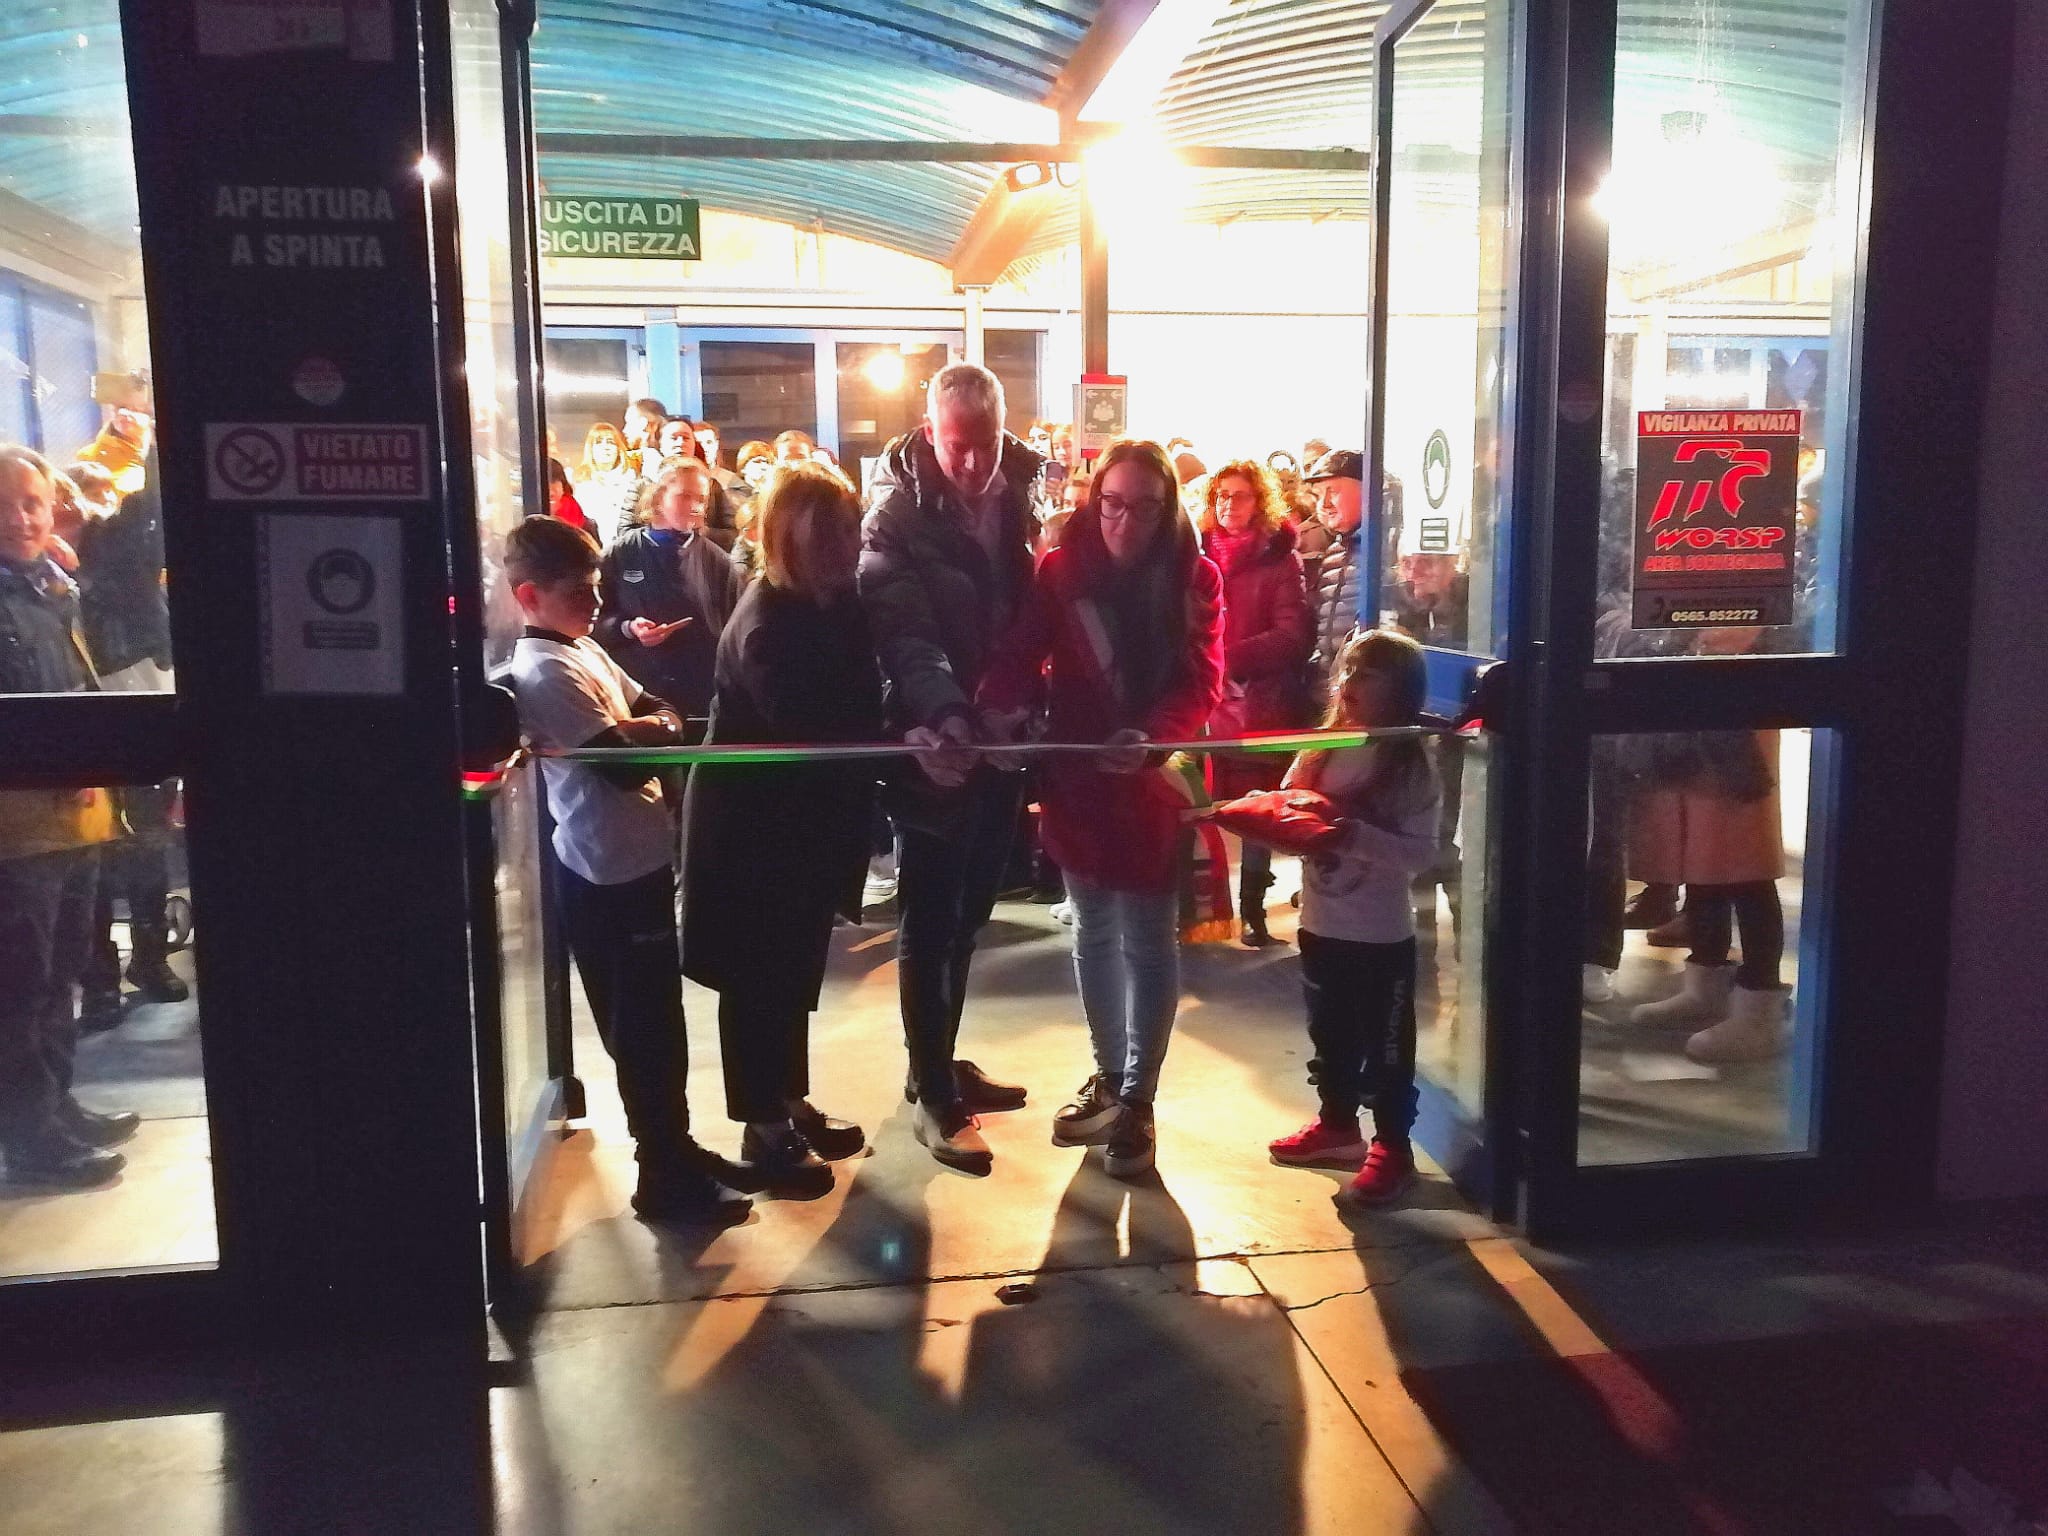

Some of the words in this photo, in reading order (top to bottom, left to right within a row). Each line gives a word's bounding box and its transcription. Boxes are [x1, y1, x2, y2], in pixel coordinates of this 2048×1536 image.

[215, 185, 394, 220] APERTURA
[543, 200, 648, 225] USCITA
[655, 203, 683, 226] DI
[231, 234, 253, 266] A
[264, 234, 385, 268] SPINTA
[540, 230, 696, 256] SICUREZZA
[1644, 414, 1729, 433] VIGILANZA
[1733, 413, 1796, 432] PRIVATA
[303, 433, 410, 459] VIETATO
[303, 465, 415, 490] FUMARE
[1654, 527, 1786, 551] WORSP
[1643, 555, 1683, 573] AREA
[1671, 609, 1760, 624] 0565.852272
